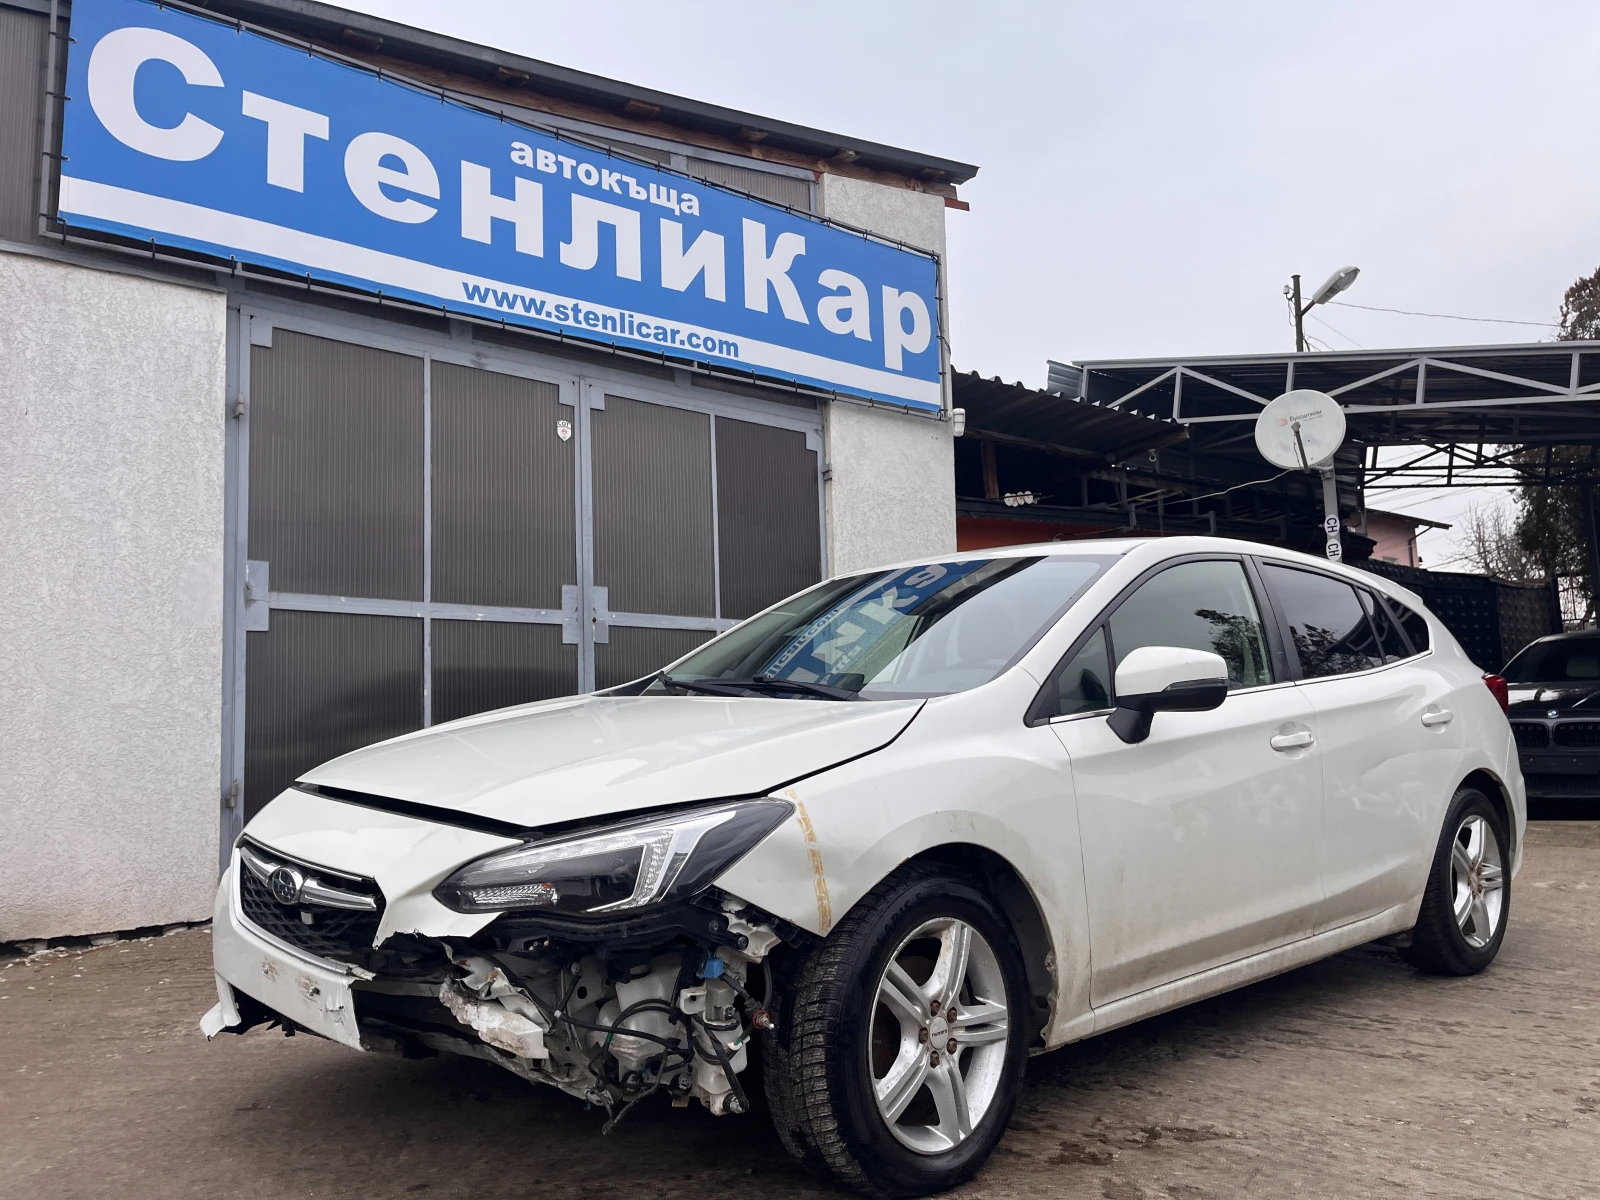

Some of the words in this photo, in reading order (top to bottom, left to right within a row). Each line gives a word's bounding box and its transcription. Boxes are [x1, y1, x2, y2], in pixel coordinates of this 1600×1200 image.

[88, 26, 931, 371] СтенлиКар
[510, 141, 699, 216] автокъща
[462, 282, 739, 359] www.stenlicar.com
[1326, 517, 1338, 533] CH
[1328, 543, 1340, 557] CH
